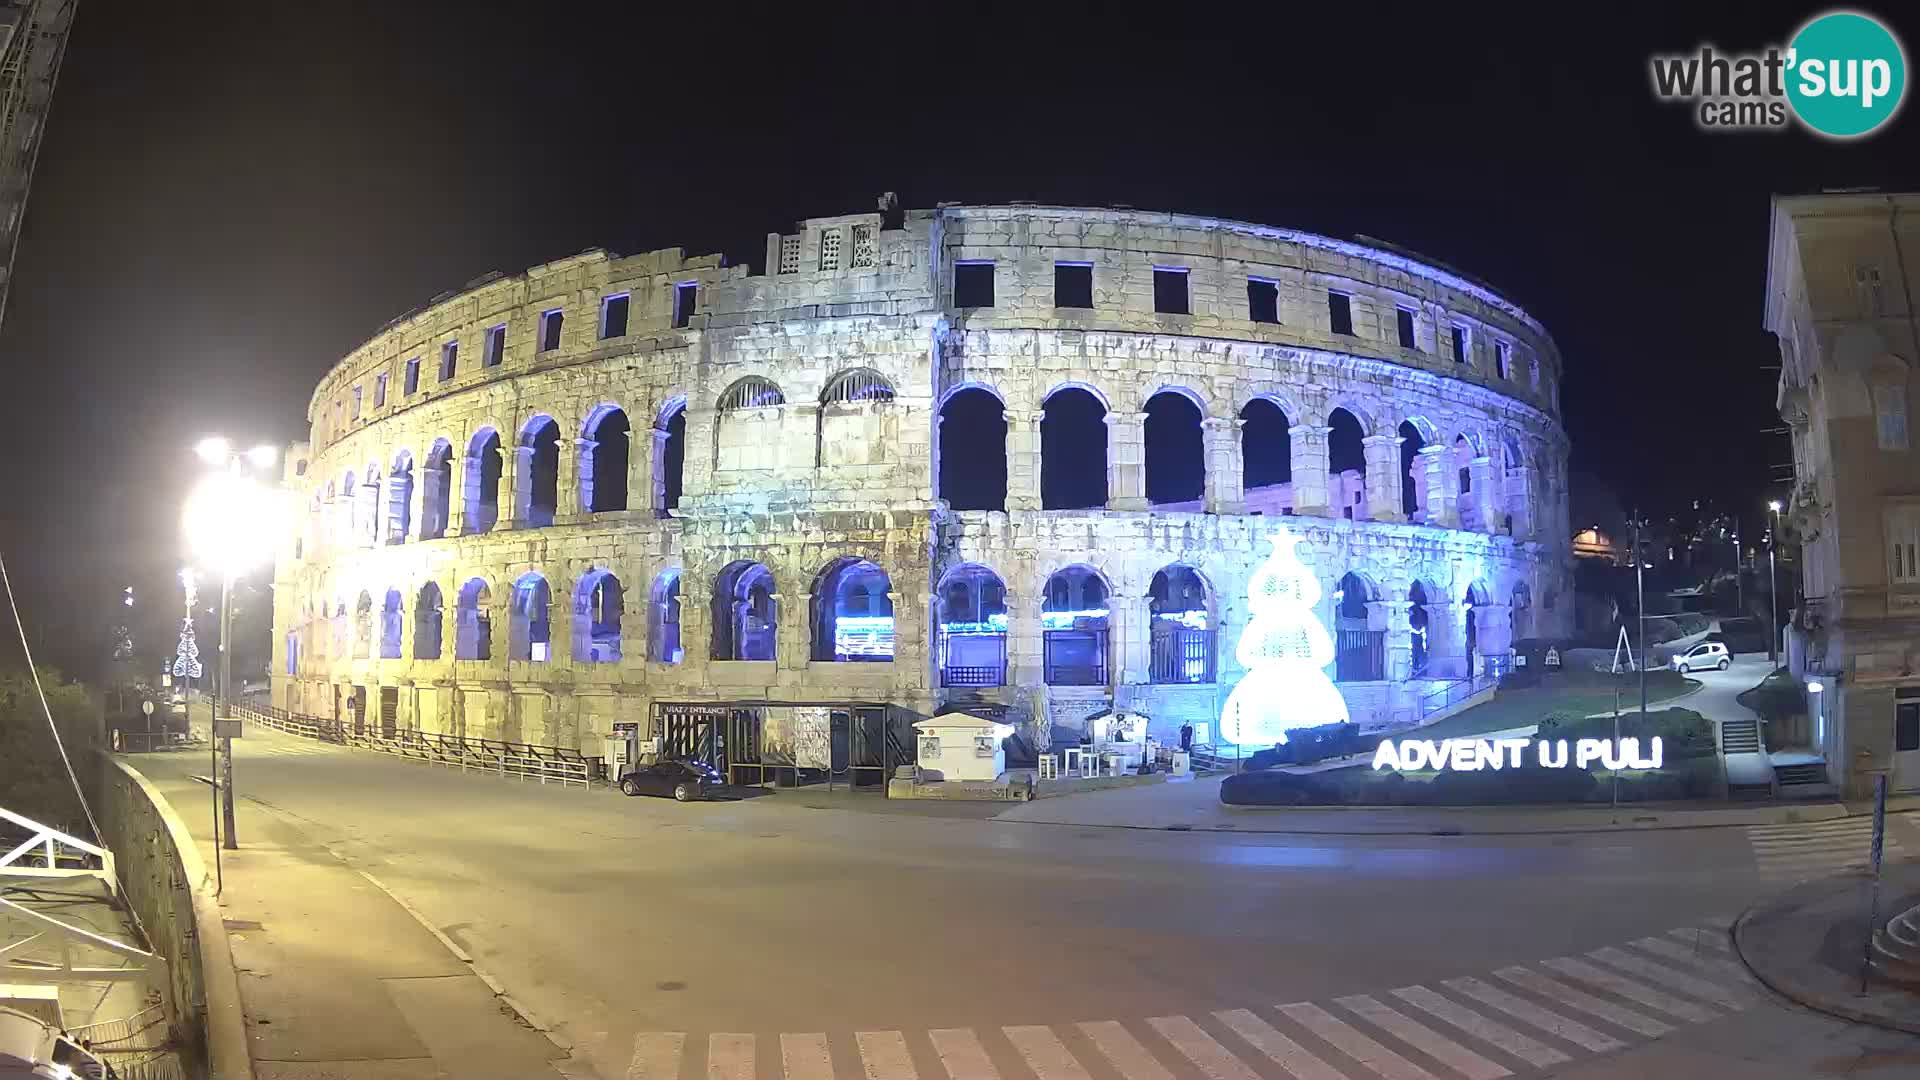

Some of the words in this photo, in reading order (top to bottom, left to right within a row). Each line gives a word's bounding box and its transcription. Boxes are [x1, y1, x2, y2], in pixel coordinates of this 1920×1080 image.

[1372, 738, 1530, 771] ADVENT
[1538, 739, 1568, 769] U
[1576, 736, 1663, 770] PULI
